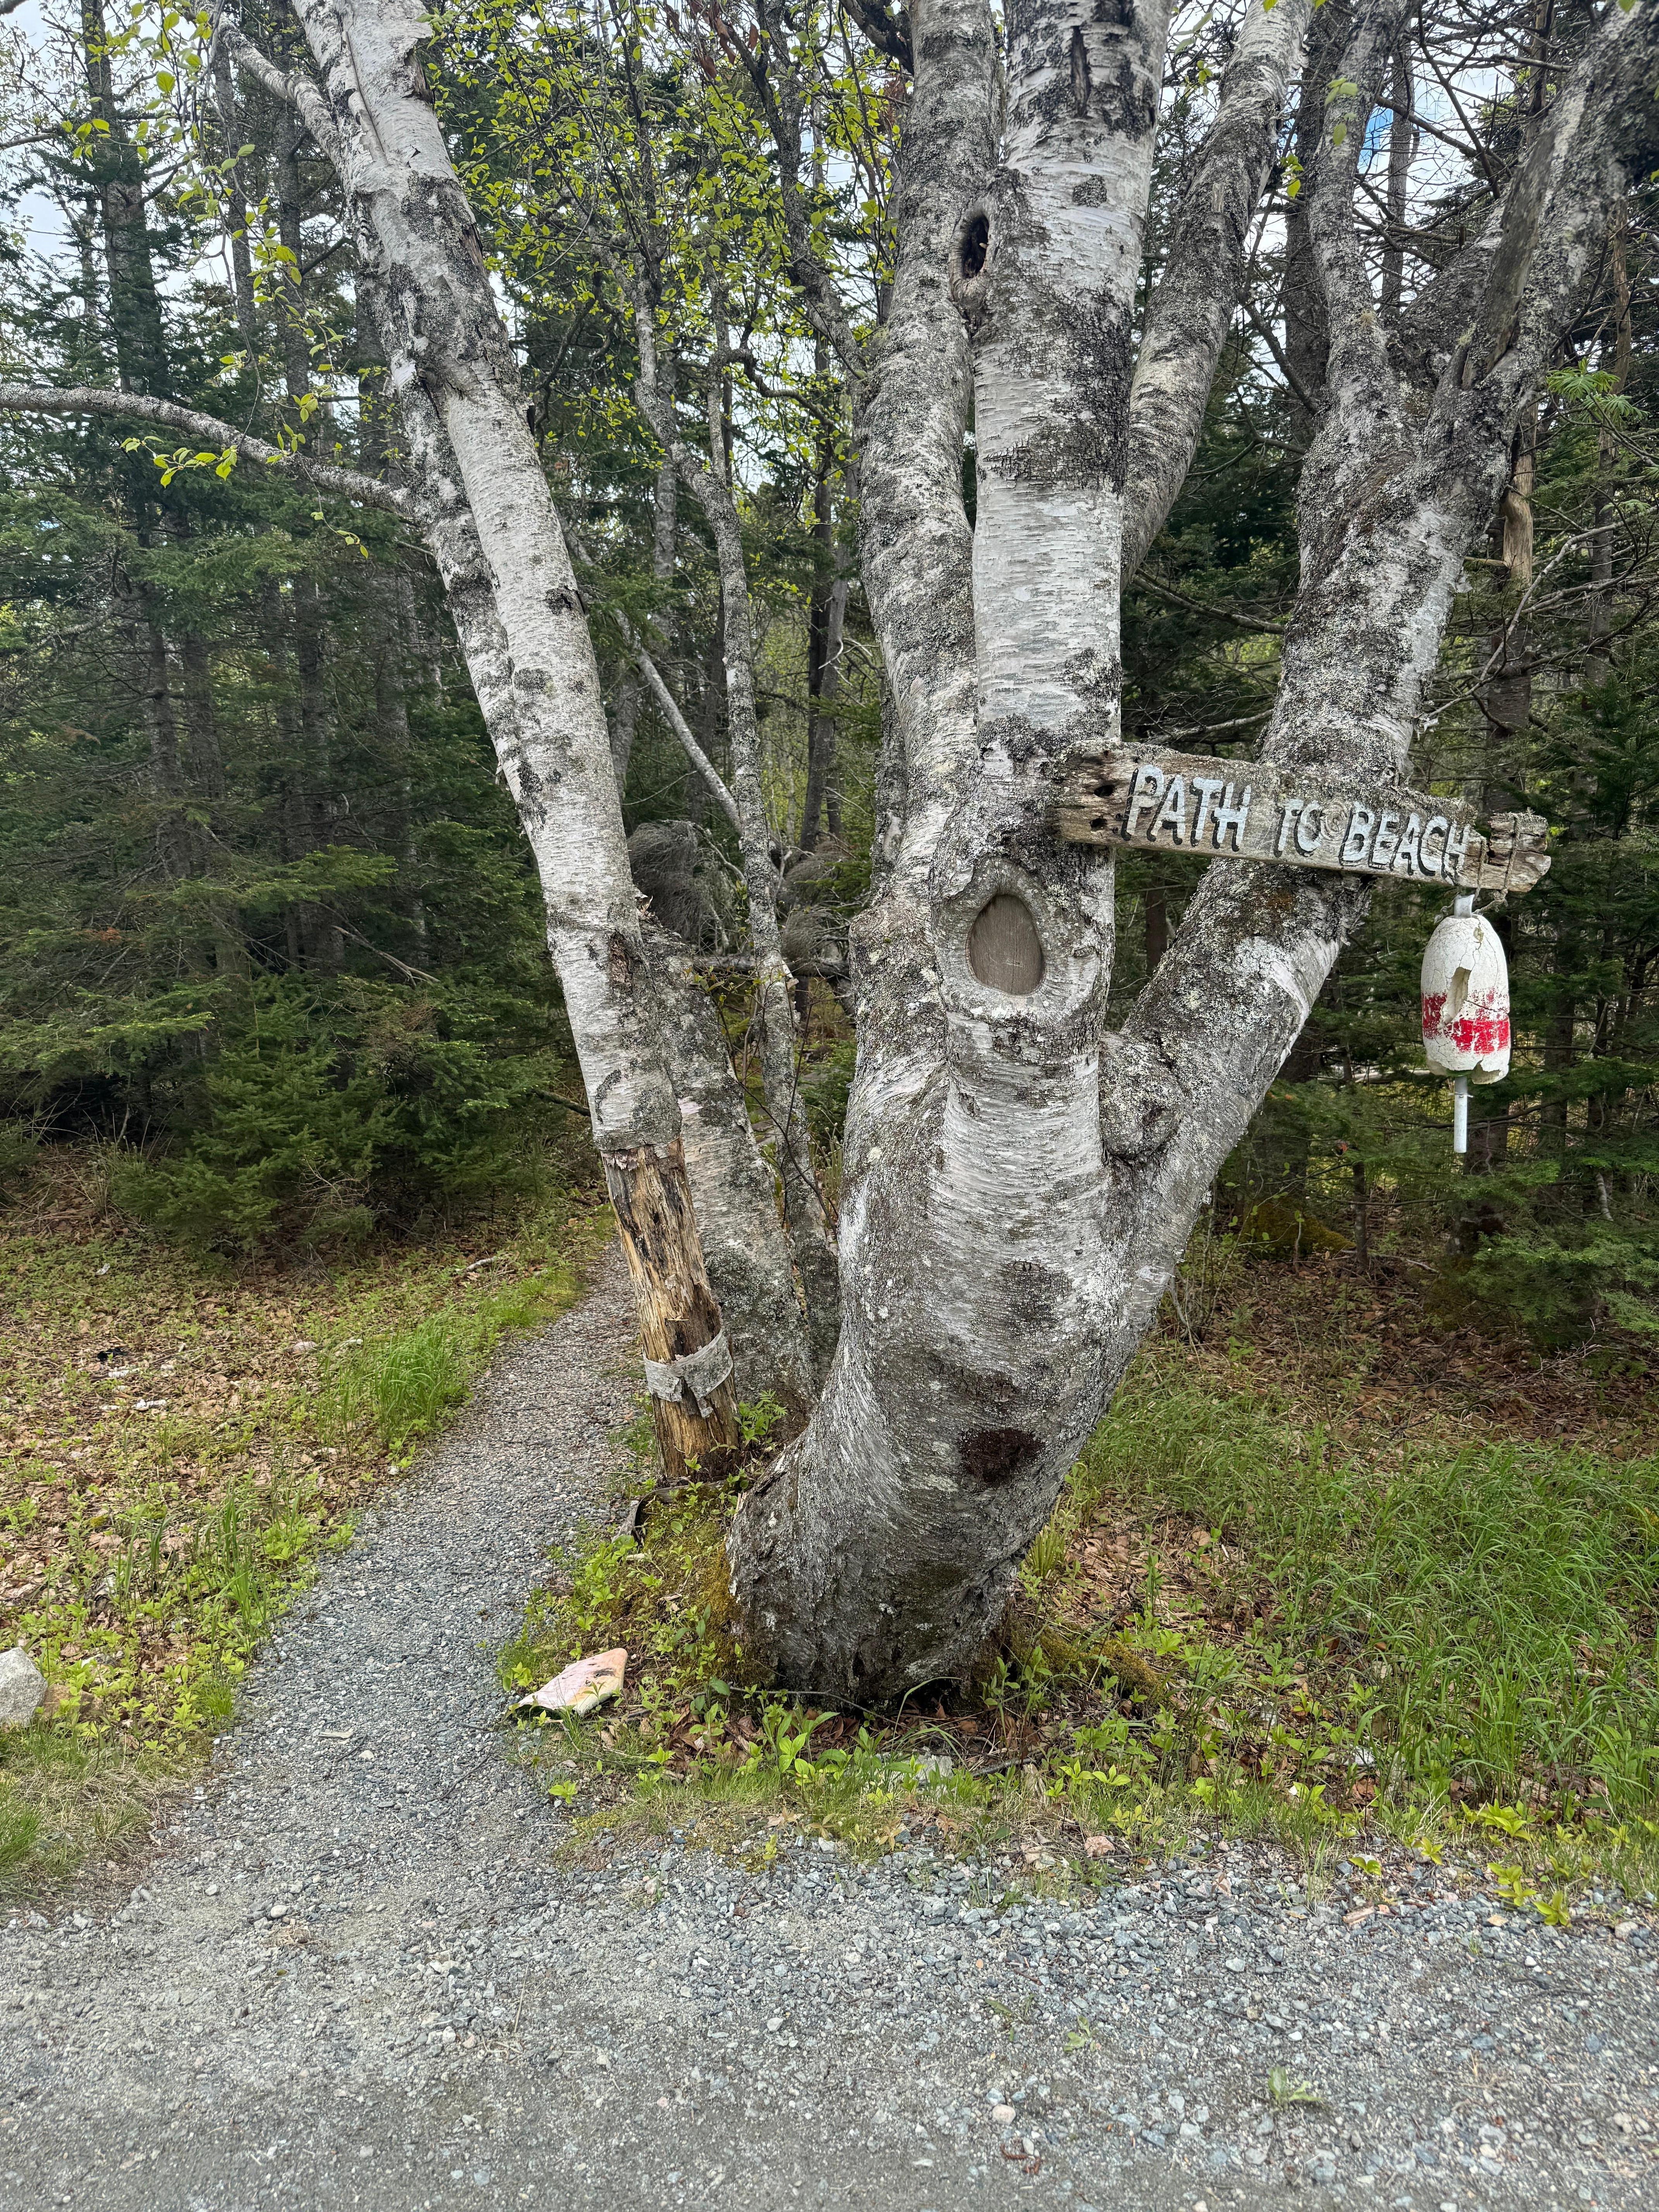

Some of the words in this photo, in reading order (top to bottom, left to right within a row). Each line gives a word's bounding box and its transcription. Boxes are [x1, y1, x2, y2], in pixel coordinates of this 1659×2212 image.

[1121, 764, 1251, 852] PATH
[1274, 798, 1323, 858] TO
[1339, 804, 1470, 886] BEACH
